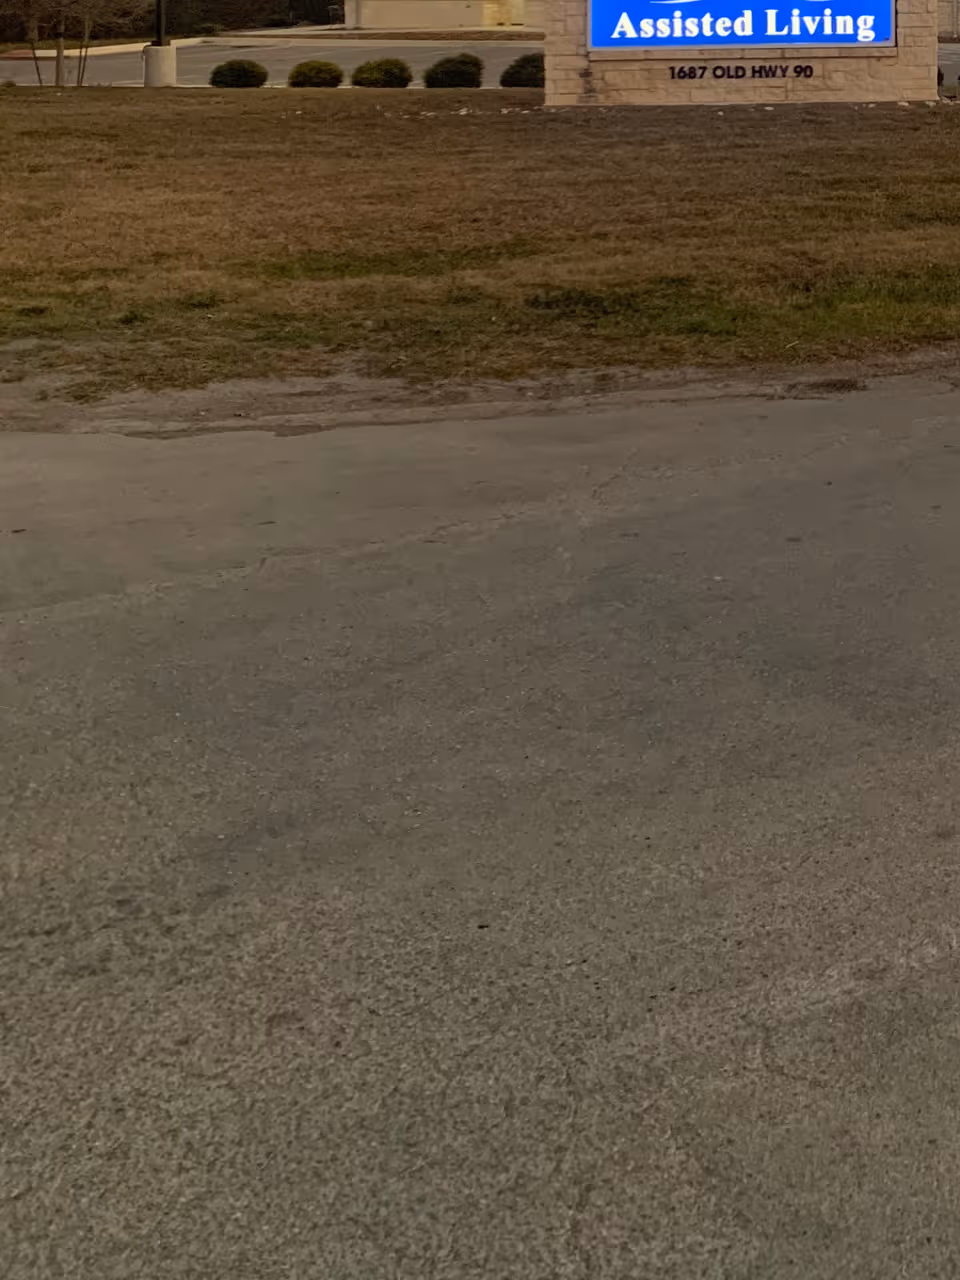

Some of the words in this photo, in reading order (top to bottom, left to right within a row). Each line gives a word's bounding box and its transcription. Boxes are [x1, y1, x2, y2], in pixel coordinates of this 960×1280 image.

[611, 10, 753, 38] Assisted
[765, 8, 875, 42] Living
[669, 66, 708, 80] 1687
[712, 66, 746, 79] OLD
[752, 65, 789, 78] HWY
[794, 65, 813, 78] 90
